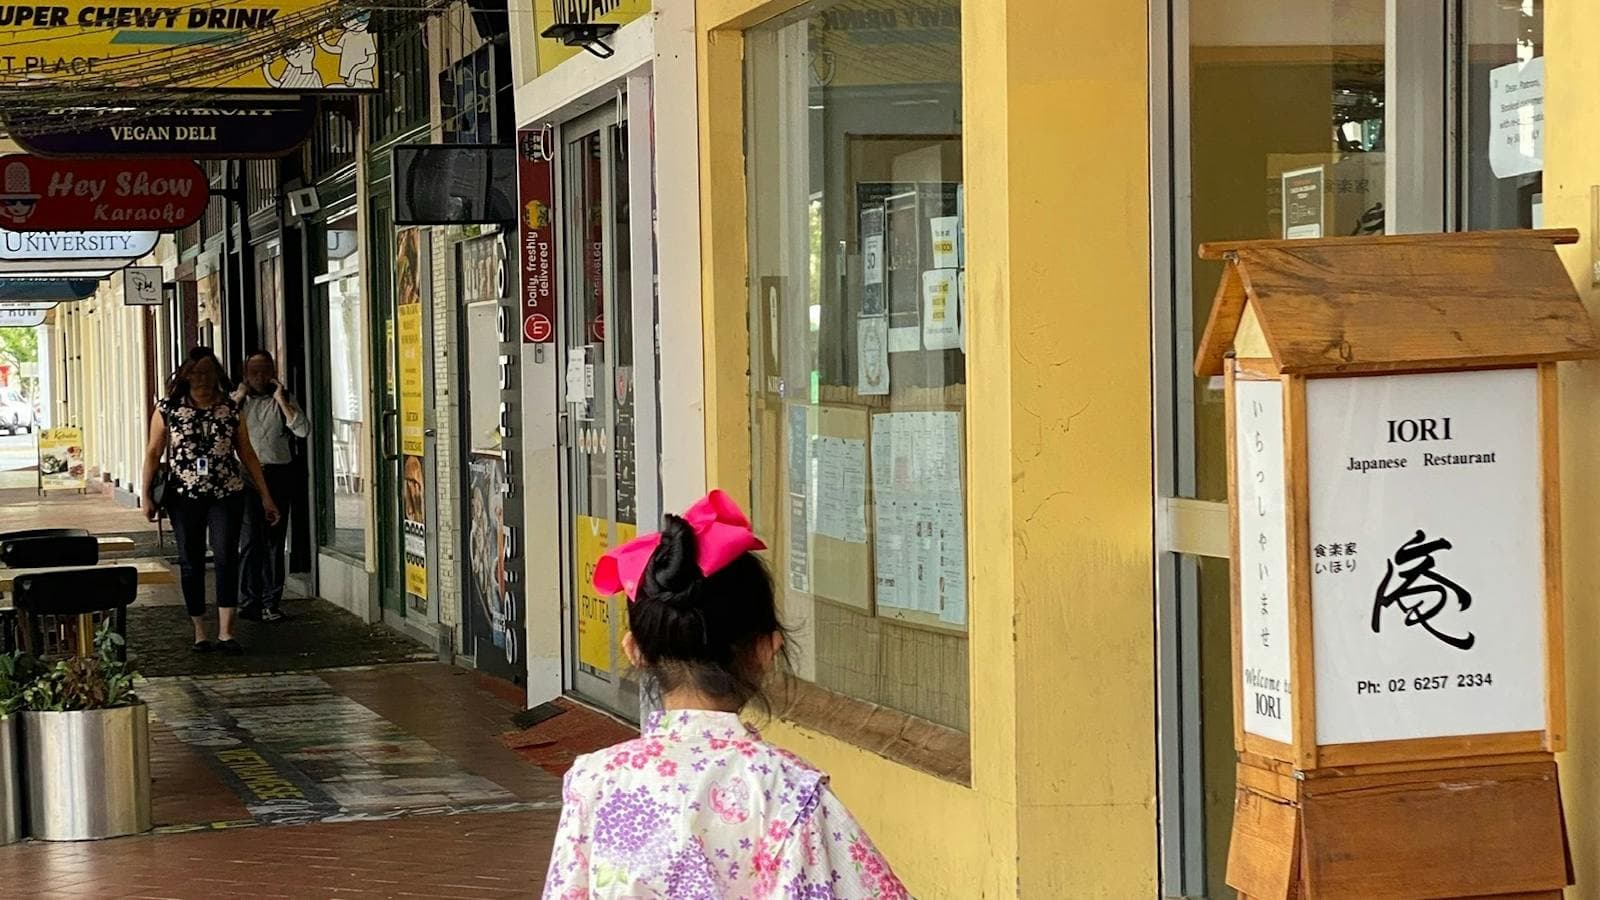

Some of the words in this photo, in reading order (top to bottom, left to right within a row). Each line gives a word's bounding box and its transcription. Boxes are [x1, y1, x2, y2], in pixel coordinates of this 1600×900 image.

[78, 6, 186, 29] CHEWY
[186, 8, 280, 30] DRINK
[26, 56, 99, 74] PLACE
[110, 126, 170, 141] VEGAN
[175, 126, 217, 141] DELI
[48, 171, 105, 201] Hey
[114, 170, 193, 198] Show
[94, 202, 186, 222] Karaoke
[5, 232, 131, 251] UNIVERSITY
[526, 231, 539, 272] freshly
[538, 242, 551, 297] delivered
[529, 274, 541, 307] Daily,
[1387, 417, 1453, 443] IORI
[1346, 457, 1408, 473] Japanese
[1423, 451, 1496, 467] Restaurant
[1314, 542, 1357, 558] 食楽家
[1314, 558, 1357, 574] いほり
[1245, 667, 1280, 692] Welcome
[1357, 679, 1381, 695] Ph:
[1388, 679, 1406, 693] 02
[1414, 675, 1449, 691] 6257
[1457, 673, 1493, 688] 2334
[1255, 692, 1281, 720] IORI
